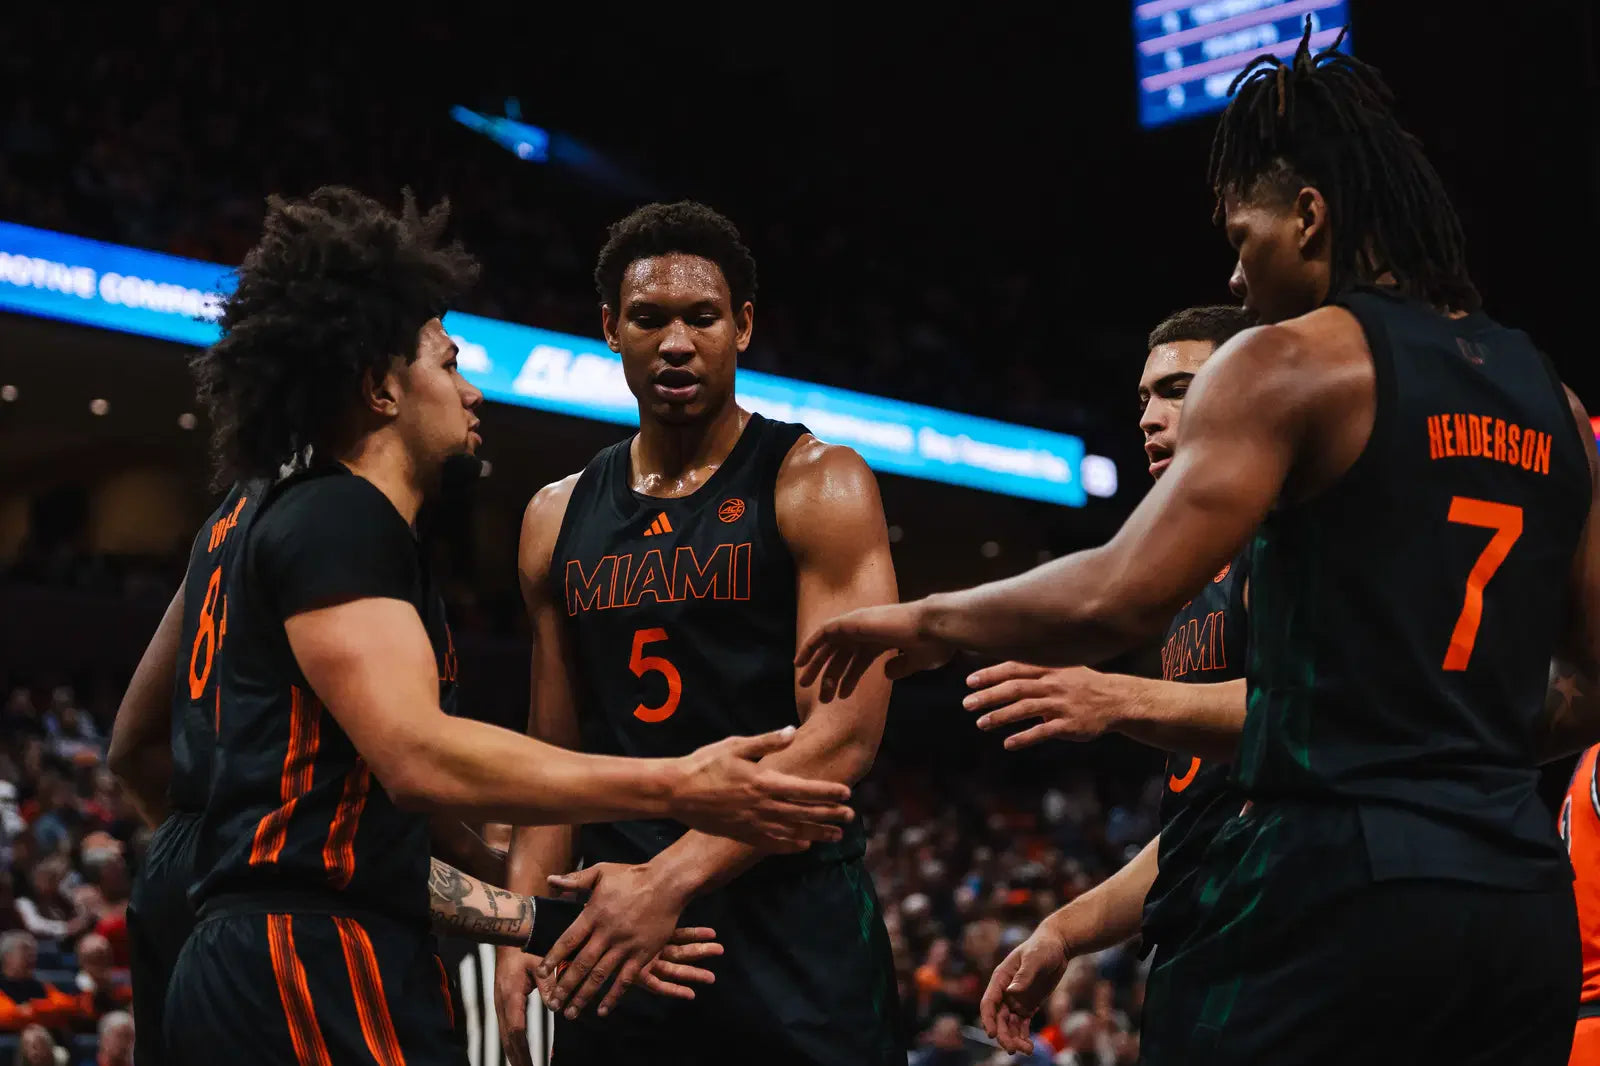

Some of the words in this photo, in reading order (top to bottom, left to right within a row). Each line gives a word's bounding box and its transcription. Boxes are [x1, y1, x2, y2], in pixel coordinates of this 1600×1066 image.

[1427, 414, 1552, 476] HENDERSON
[565, 543, 752, 616] MIAMI
[1442, 496, 1523, 671] 7
[629, 627, 683, 723] 5
